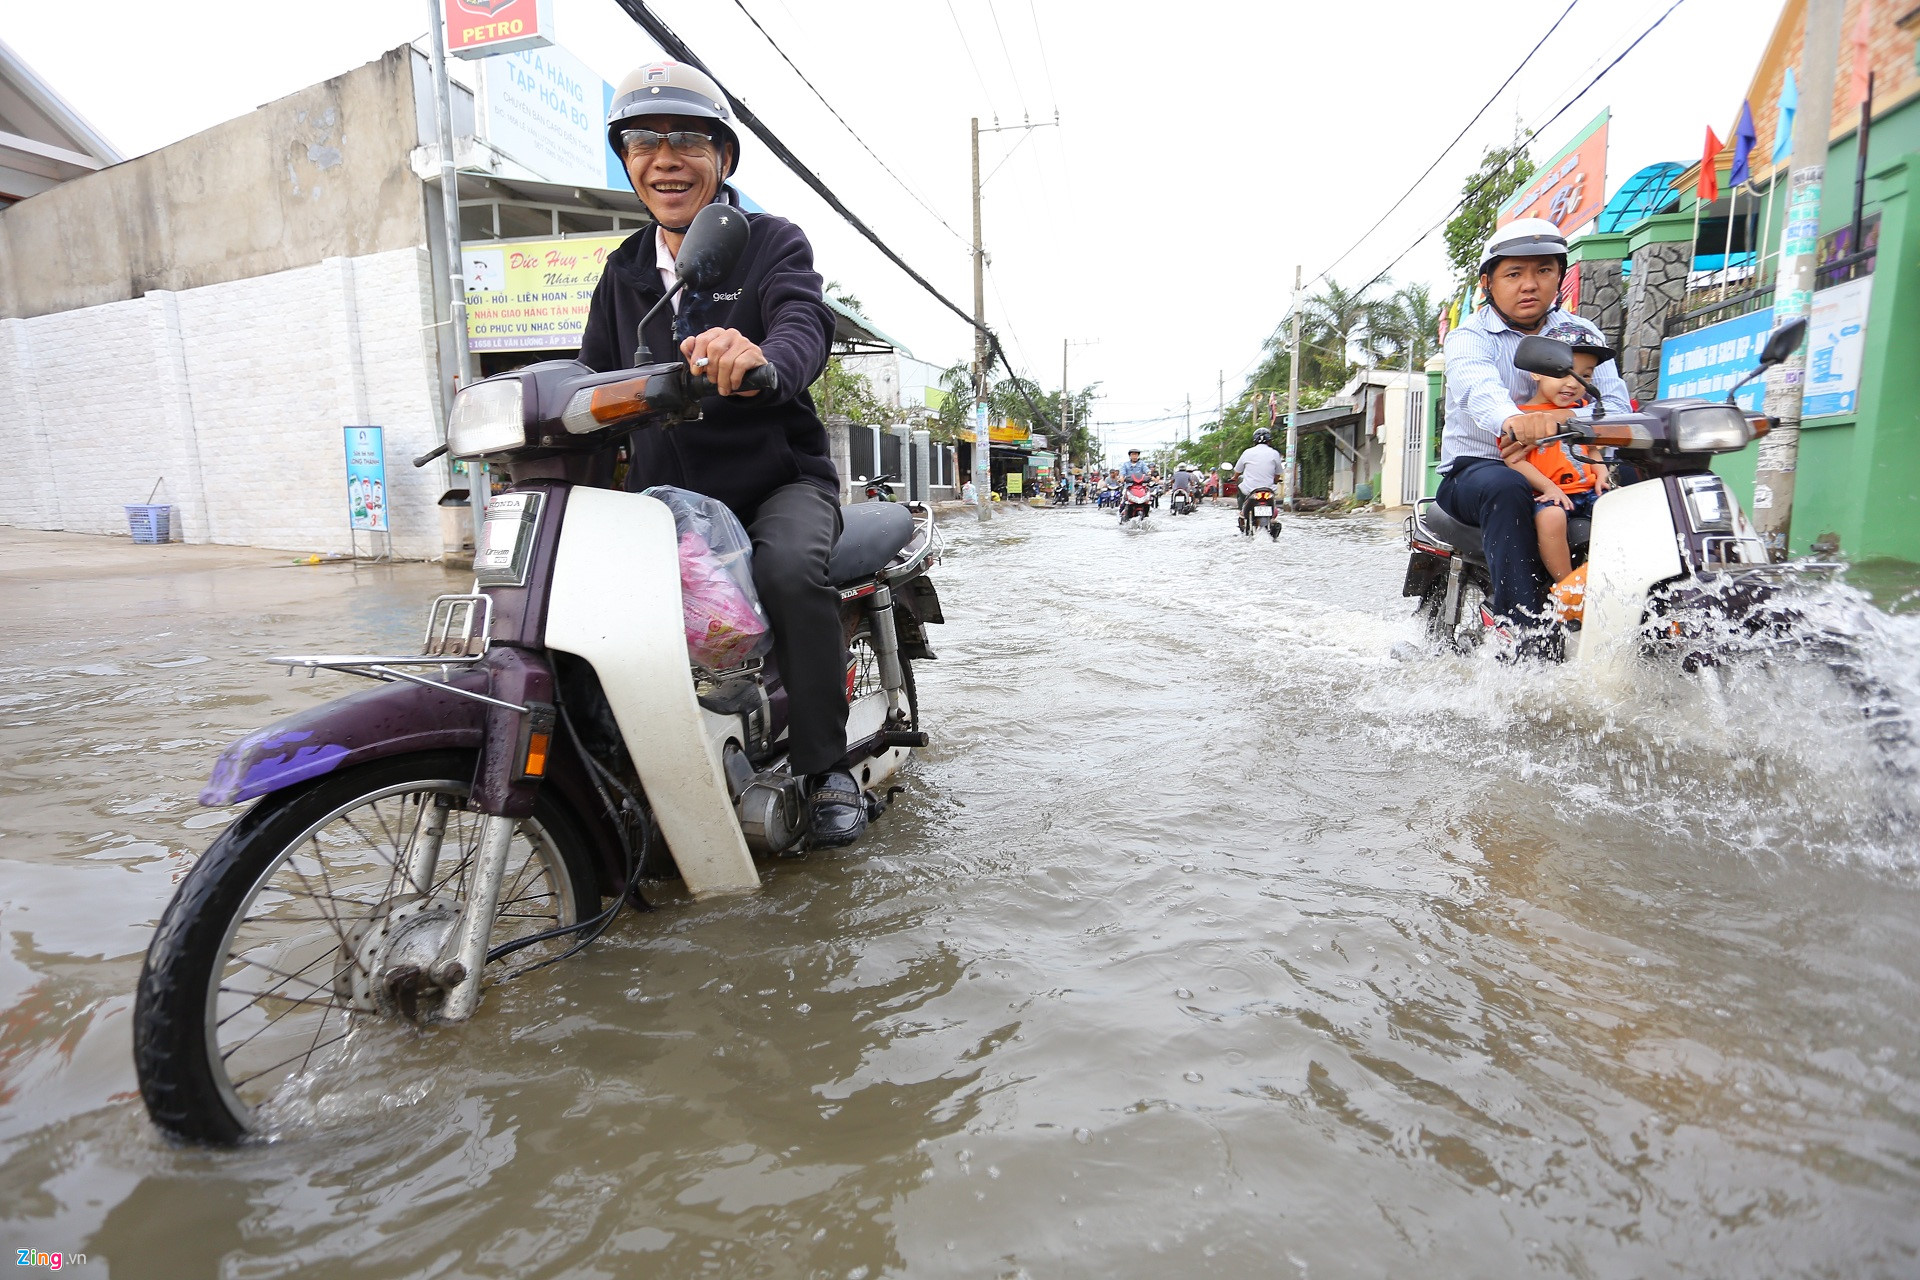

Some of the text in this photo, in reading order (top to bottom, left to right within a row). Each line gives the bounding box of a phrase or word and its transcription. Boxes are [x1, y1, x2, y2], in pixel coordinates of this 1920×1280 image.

[463, 19, 524, 44] PETRO
[547, 62, 583, 103] HÀNG
[503, 91, 532, 117] CHUYÊN
[507, 61, 589, 131] TẠP HÓA BO
[510, 251, 539, 270] Đức
[545, 250, 577, 270] Huy
[517, 291, 539, 303] LIÊN
[541, 291, 567, 302] HOAN
[577, 289, 594, 300] SIN
[501, 308, 521, 319] GIAO
[475, 318, 582, 334] CÓ PHỤC VỤ NHẠC SỐNG
[488, 500, 521, 509] HONDA
[485, 548, 510, 556] Dream
